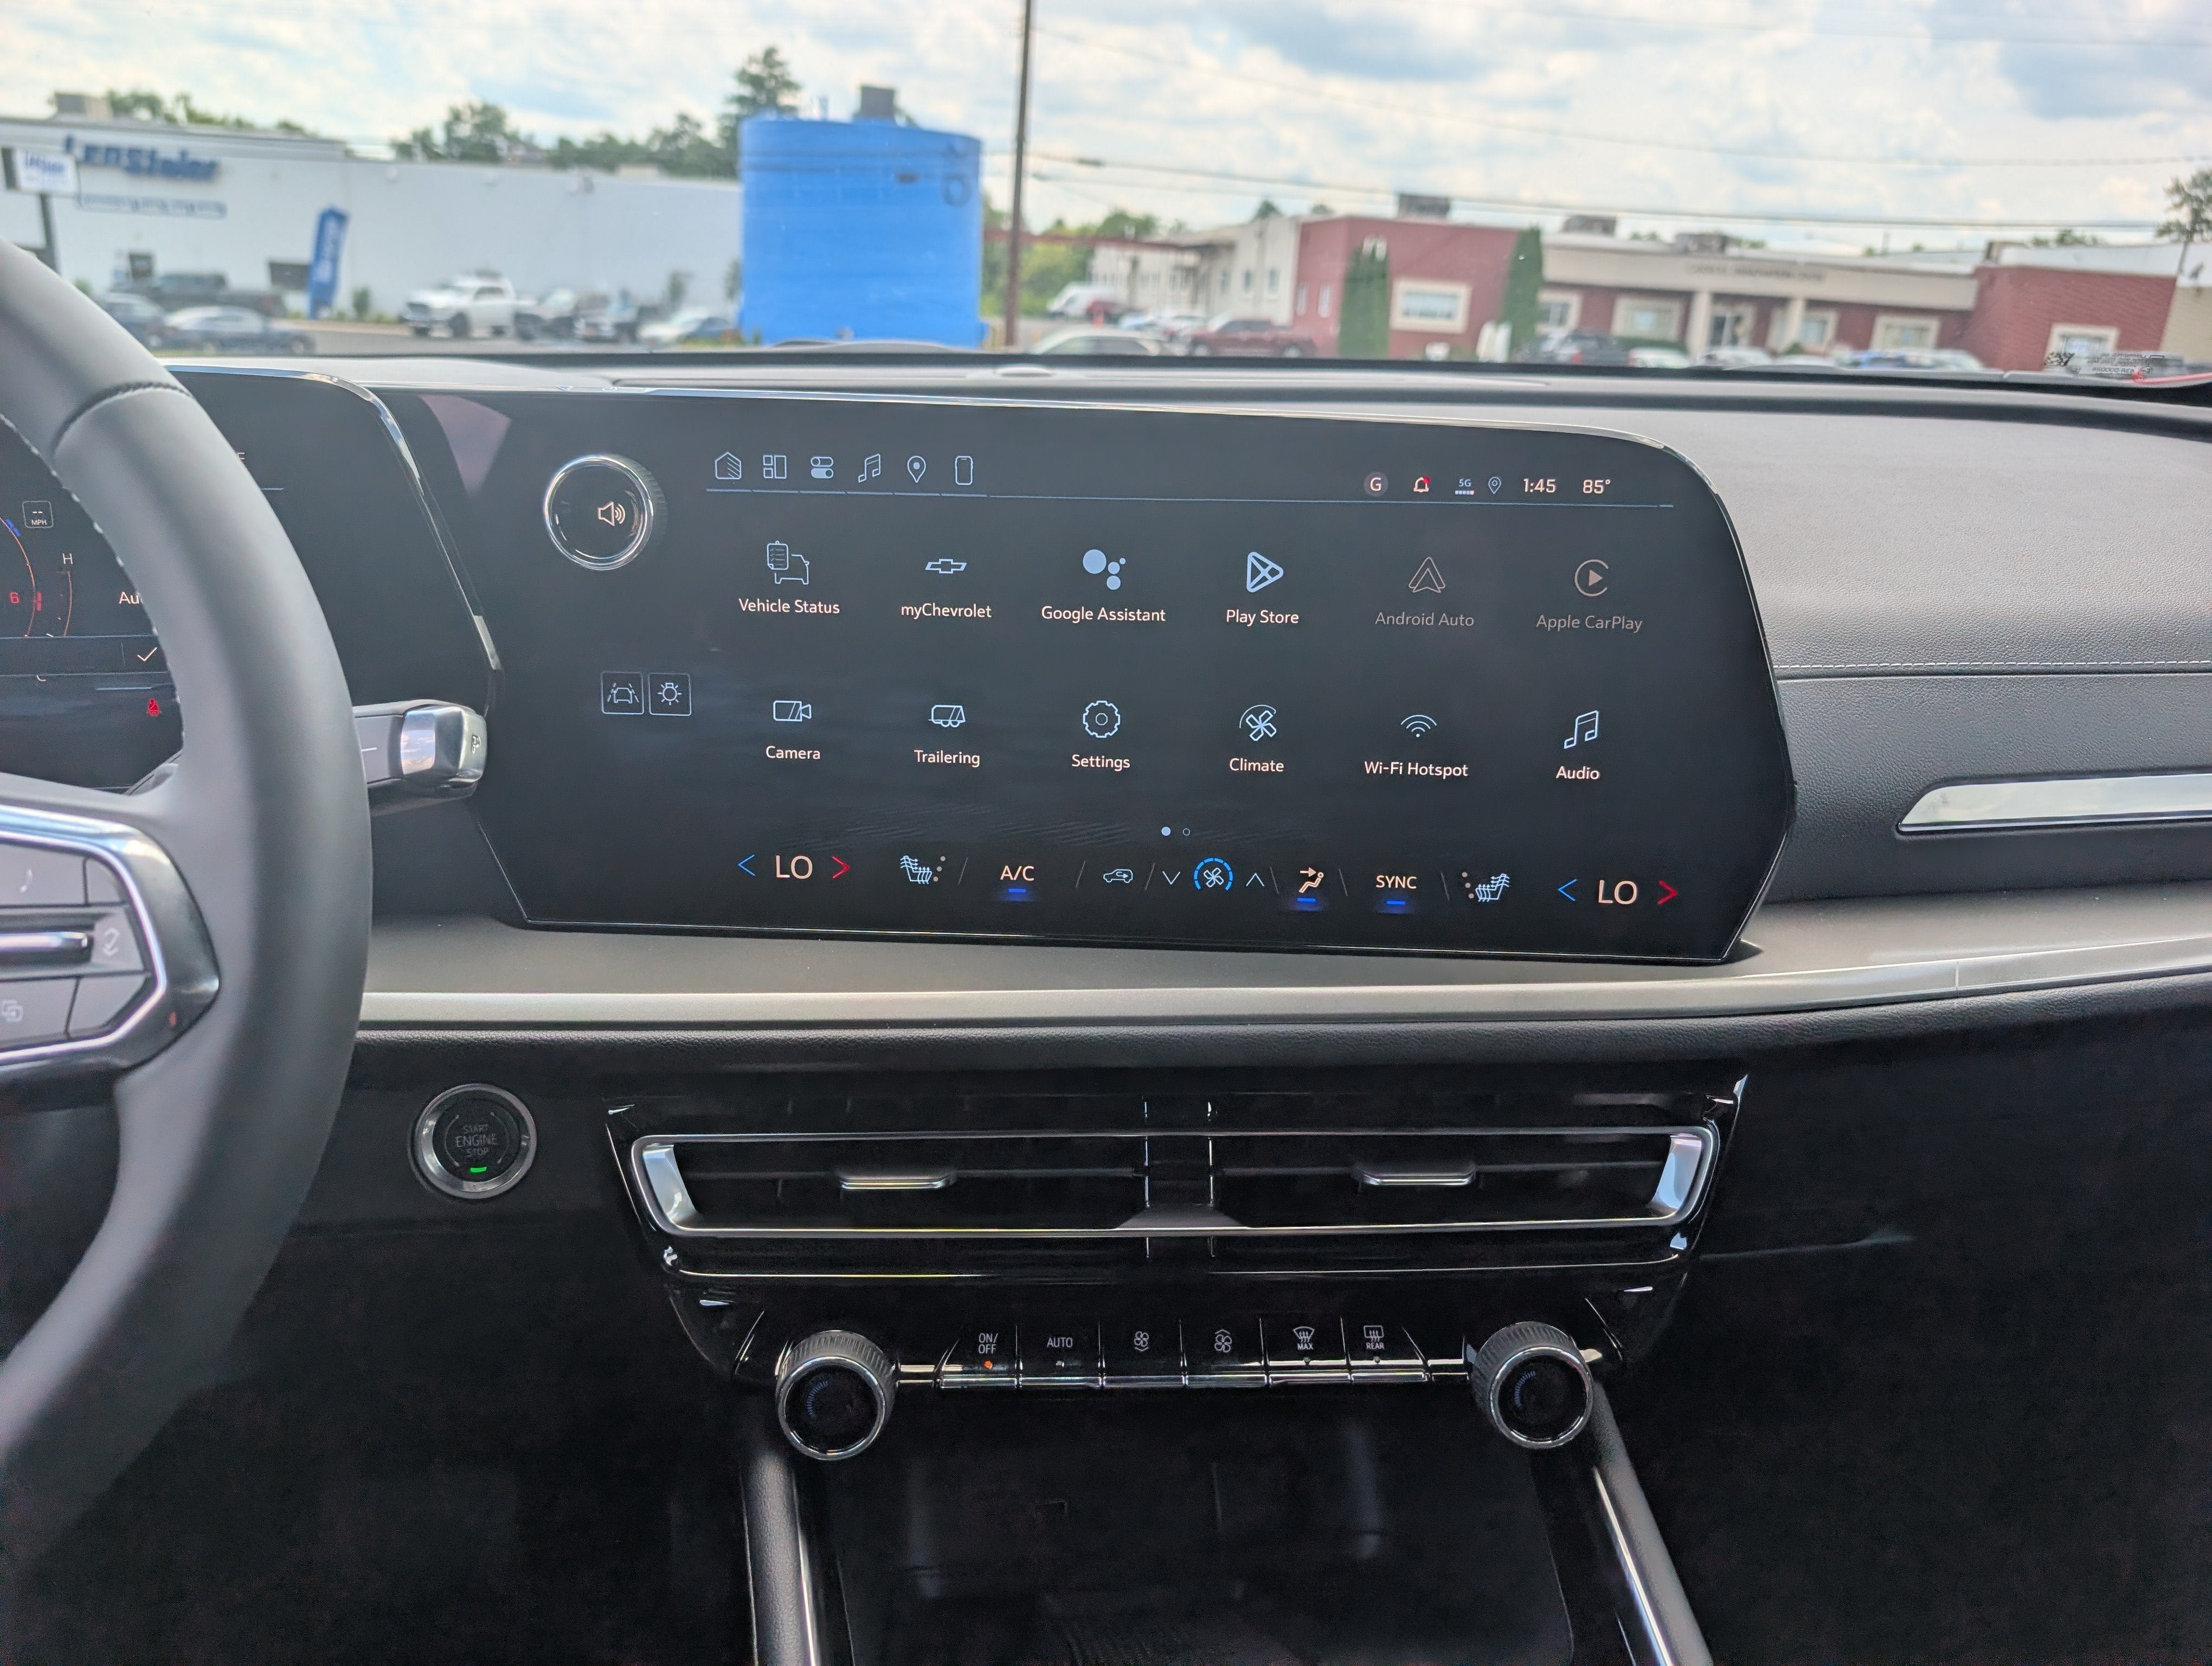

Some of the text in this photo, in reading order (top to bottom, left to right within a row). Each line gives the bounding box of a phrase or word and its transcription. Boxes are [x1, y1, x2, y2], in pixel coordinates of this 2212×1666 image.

[1370, 477, 1381, 491] G
[1459, 479, 1471, 487] 5G
[1523, 478, 1555, 493] 1:45
[1583, 479, 1611, 494] 85°
[62, 553, 73, 565] H
[738, 598, 840, 614] Vehicle Status
[901, 603, 992, 620] myChevrolet
[1041, 606, 1166, 624] Google Assistant
[1226, 609, 1299, 627] Play Store
[1375, 611, 1474, 626] Android Auto
[1536, 614, 1643, 633] Apple CarPlay
[766, 745, 820, 760] Camera
[914, 749, 980, 768] Trailering
[1072, 754, 1130, 772] Settings
[1229, 758, 1284, 772] Climate
[1364, 761, 1468, 779] Wi-Fi Hotspot
[1555, 766, 1600, 780] Audio
[776, 855, 813, 879] LO
[1000, 865, 1034, 881] A/C
[1375, 875, 1417, 889] SYNC
[1598, 880, 1637, 905] LO
[456, 1134, 498, 1147] ENGINE
[979, 1332, 998, 1343] ON/
[1046, 1337, 1073, 1348] AUTO
[978, 1344, 996, 1354] OFF
